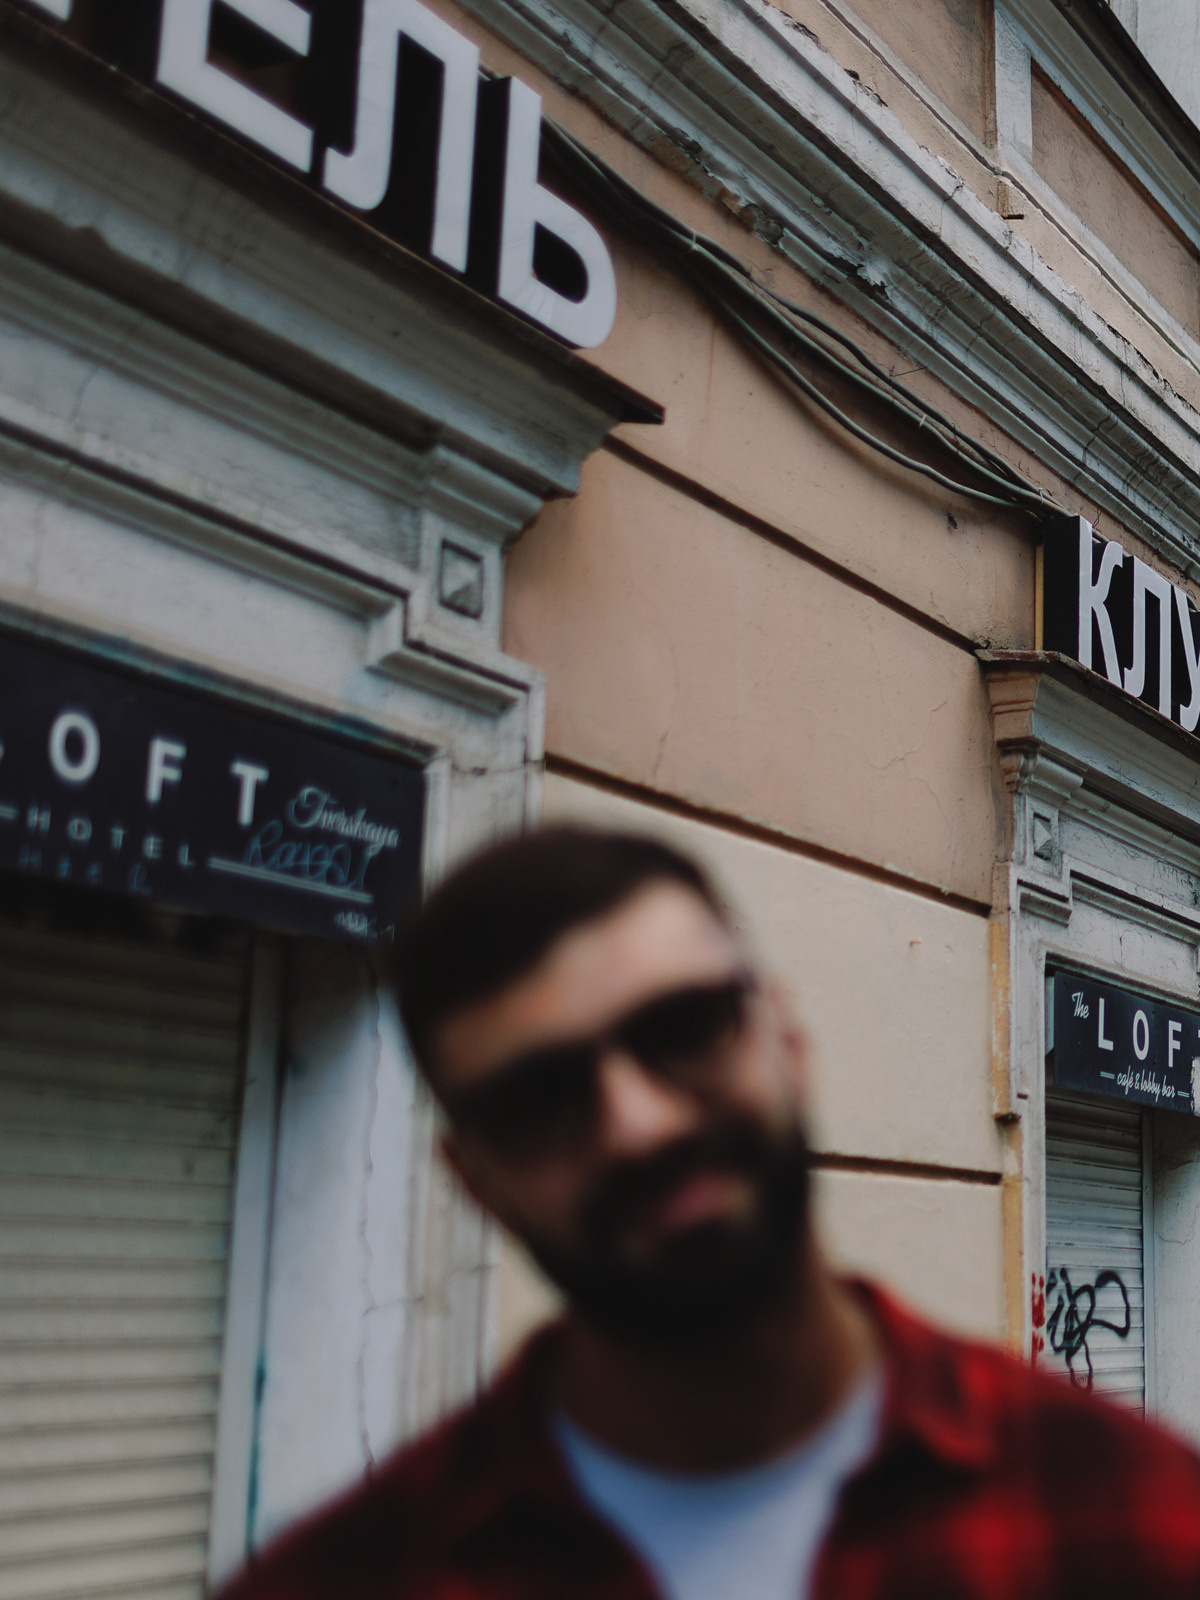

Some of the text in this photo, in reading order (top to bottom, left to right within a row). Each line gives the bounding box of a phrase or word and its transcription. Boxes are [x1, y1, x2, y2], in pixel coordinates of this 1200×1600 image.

[28, 0, 618, 349] ЕЛЬ
[0, 709, 270, 829] OFT
[26, 804, 196, 868] HOTEL
[1072, 991, 1090, 1019] The
[1117, 1065, 1134, 1096] café
[1140, 1069, 1160, 1103] lobby
[1161, 1074, 1176, 1099] bar
